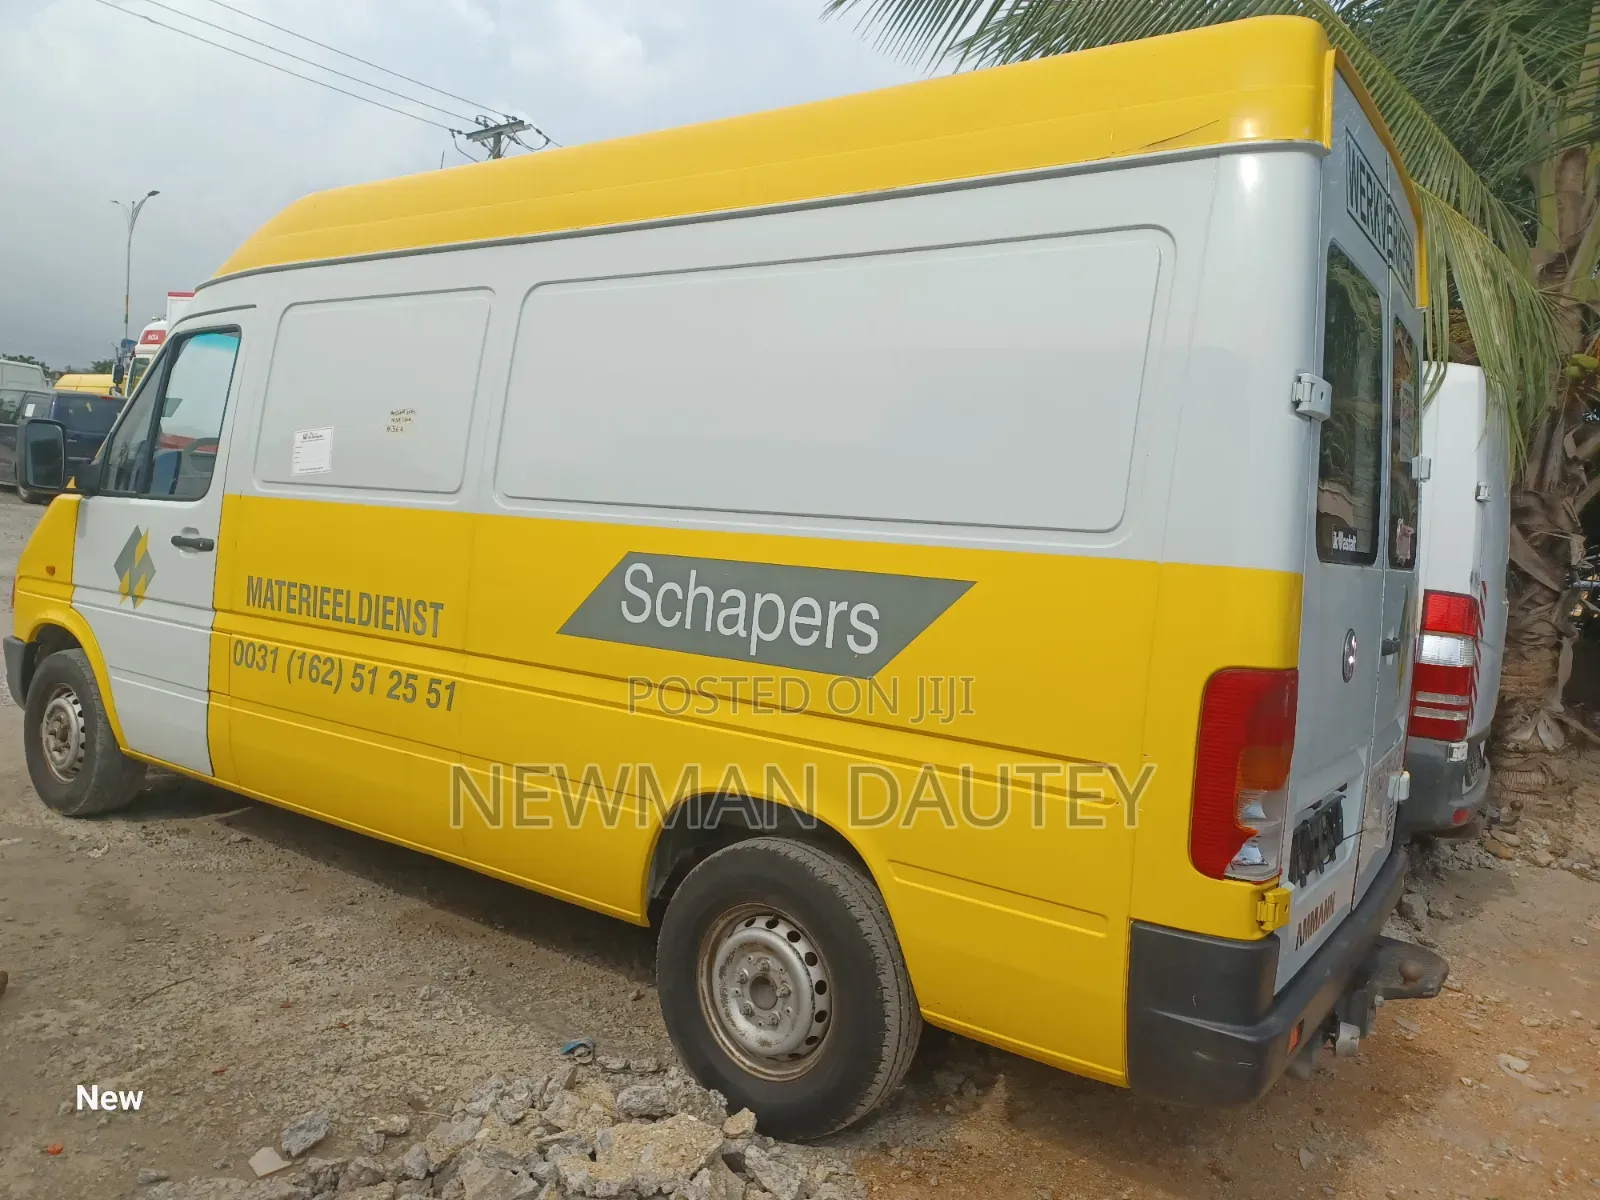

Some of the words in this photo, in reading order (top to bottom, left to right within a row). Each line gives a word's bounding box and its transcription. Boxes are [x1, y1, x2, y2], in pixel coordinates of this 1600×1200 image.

[246, 575, 444, 638] MATERIEELDIENST
[620, 563, 880, 656] Schapers
[233, 639, 279, 674] 0031
[287, 649, 343, 694] (162)
[351, 662, 378, 695] 51
[387, 670, 418, 704] 25
[426, 678, 456, 711] 51
[1295, 891, 1336, 951] AMMANN
